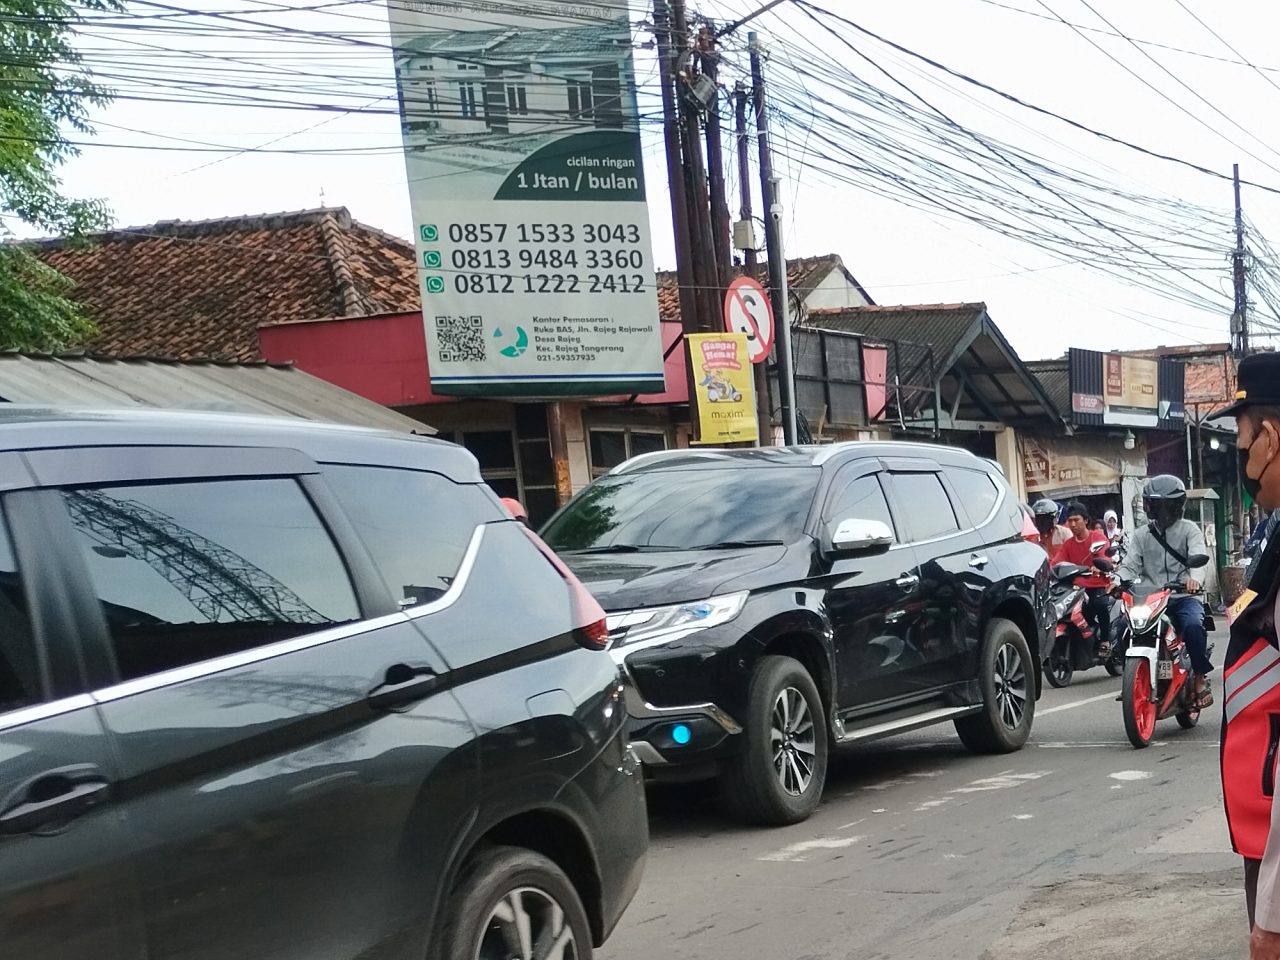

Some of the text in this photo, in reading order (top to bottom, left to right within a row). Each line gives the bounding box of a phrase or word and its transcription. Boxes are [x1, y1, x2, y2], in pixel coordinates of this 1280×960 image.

[566, 156, 635, 169] cicilan ringan
[517, 173, 528, 188] 1
[574, 171, 583, 192] /
[588, 172, 638, 189] bulan
[449, 223, 641, 244] 0857 1533 3043
[451, 249, 643, 269] 0813 9484 3360
[454, 274, 646, 294] 0812 1222 2412
[711, 410, 743, 419] maxim
